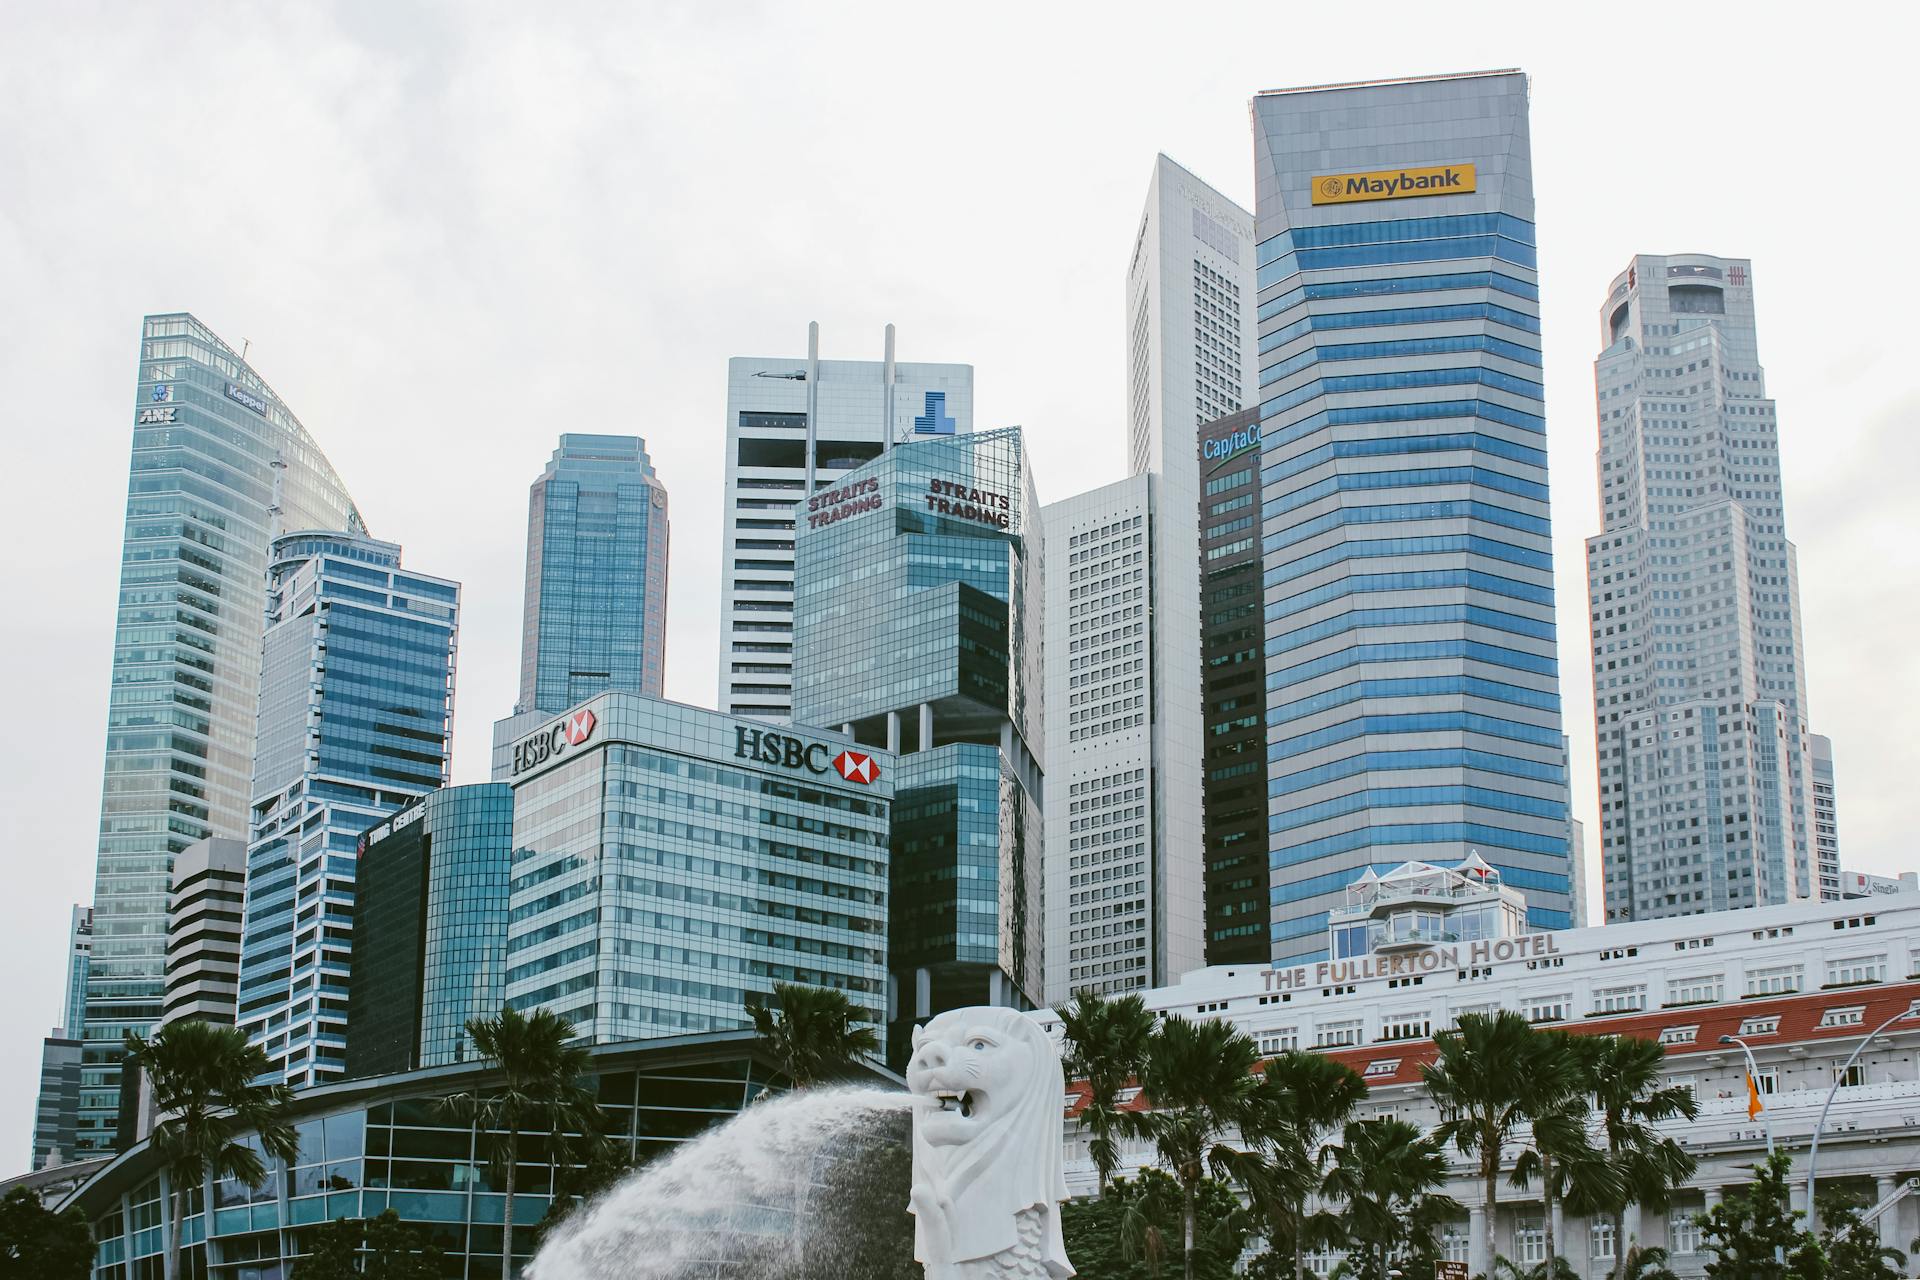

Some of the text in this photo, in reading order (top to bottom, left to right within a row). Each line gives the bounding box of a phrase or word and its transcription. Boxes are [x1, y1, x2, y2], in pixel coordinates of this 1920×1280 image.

[1346, 169, 1461, 196] Maybank
[139, 408, 176, 423] ANZ
[229, 384, 266, 412] Keppel
[807, 493, 883, 530] TRADING
[808, 476, 879, 512] STRAITS
[925, 494, 1010, 529] TRADING
[930, 478, 1010, 510] STRAITS
[511, 721, 566, 776] HSBC
[735, 725, 828, 775] HSBC
[393, 801, 426, 833] CENTRE
[1260, 933, 1560, 991] THE FULLERTON HOTEL
